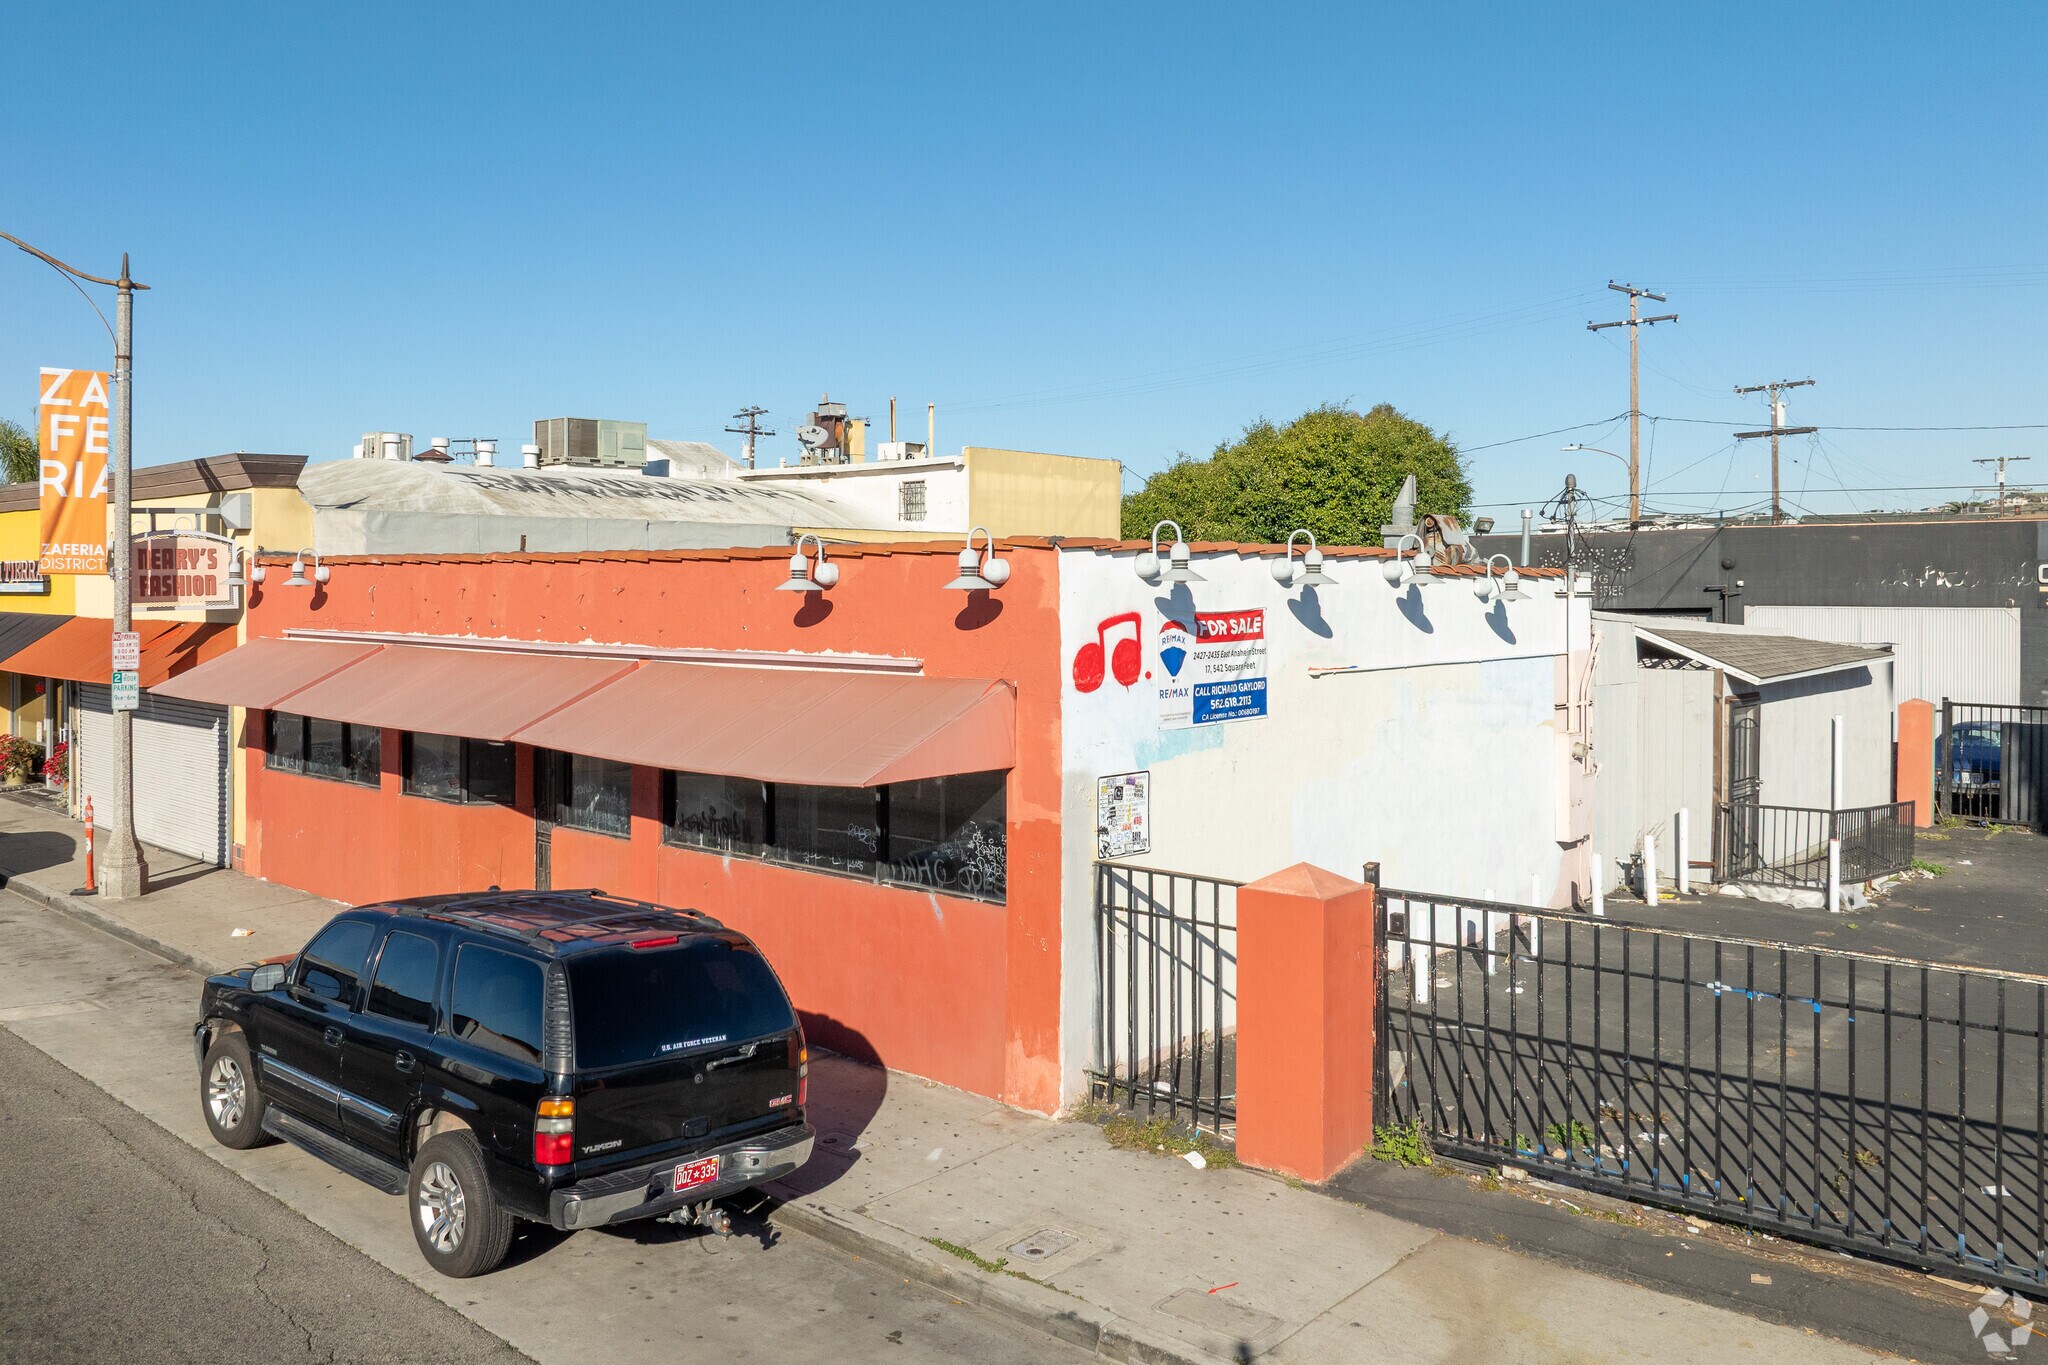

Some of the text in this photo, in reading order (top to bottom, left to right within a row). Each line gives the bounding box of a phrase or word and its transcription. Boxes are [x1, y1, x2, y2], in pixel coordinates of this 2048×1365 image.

[39, 367, 108, 408] ZA
[50, 413, 108, 453] FE
[41, 543, 105, 556] ZAFERIA
[40, 557, 105, 570] DISTRICT
[137, 548, 218, 570] NEARY'S
[140, 575, 217, 597] FASHION
[1198, 616, 1262, 636] FOR SALE
[1161, 634, 1186, 646] RE/MAX
[1193, 647, 1267, 660] 2427-2435 East Anaheim Street
[1213, 664, 1224, 672] 542
[1224, 663, 1243, 674] Square
[1243, 661, 1256, 670] Feet
[114, 674, 120, 682] 2
[1159, 687, 1189, 699] RE/MAX
[1194, 680, 1266, 697] CALL RICHARD GAYLORD
[1210, 695, 1252, 709] 562.618.2113
[1201, 713, 1209, 721] CA
[672, 1042, 684, 1050] AIR
[683, 1039, 701, 1048] FORCE
[701, 1034, 727, 1044] VETERAN
[769, 1094, 793, 1108] GMC
[581, 1139, 622, 1154] YUKON
